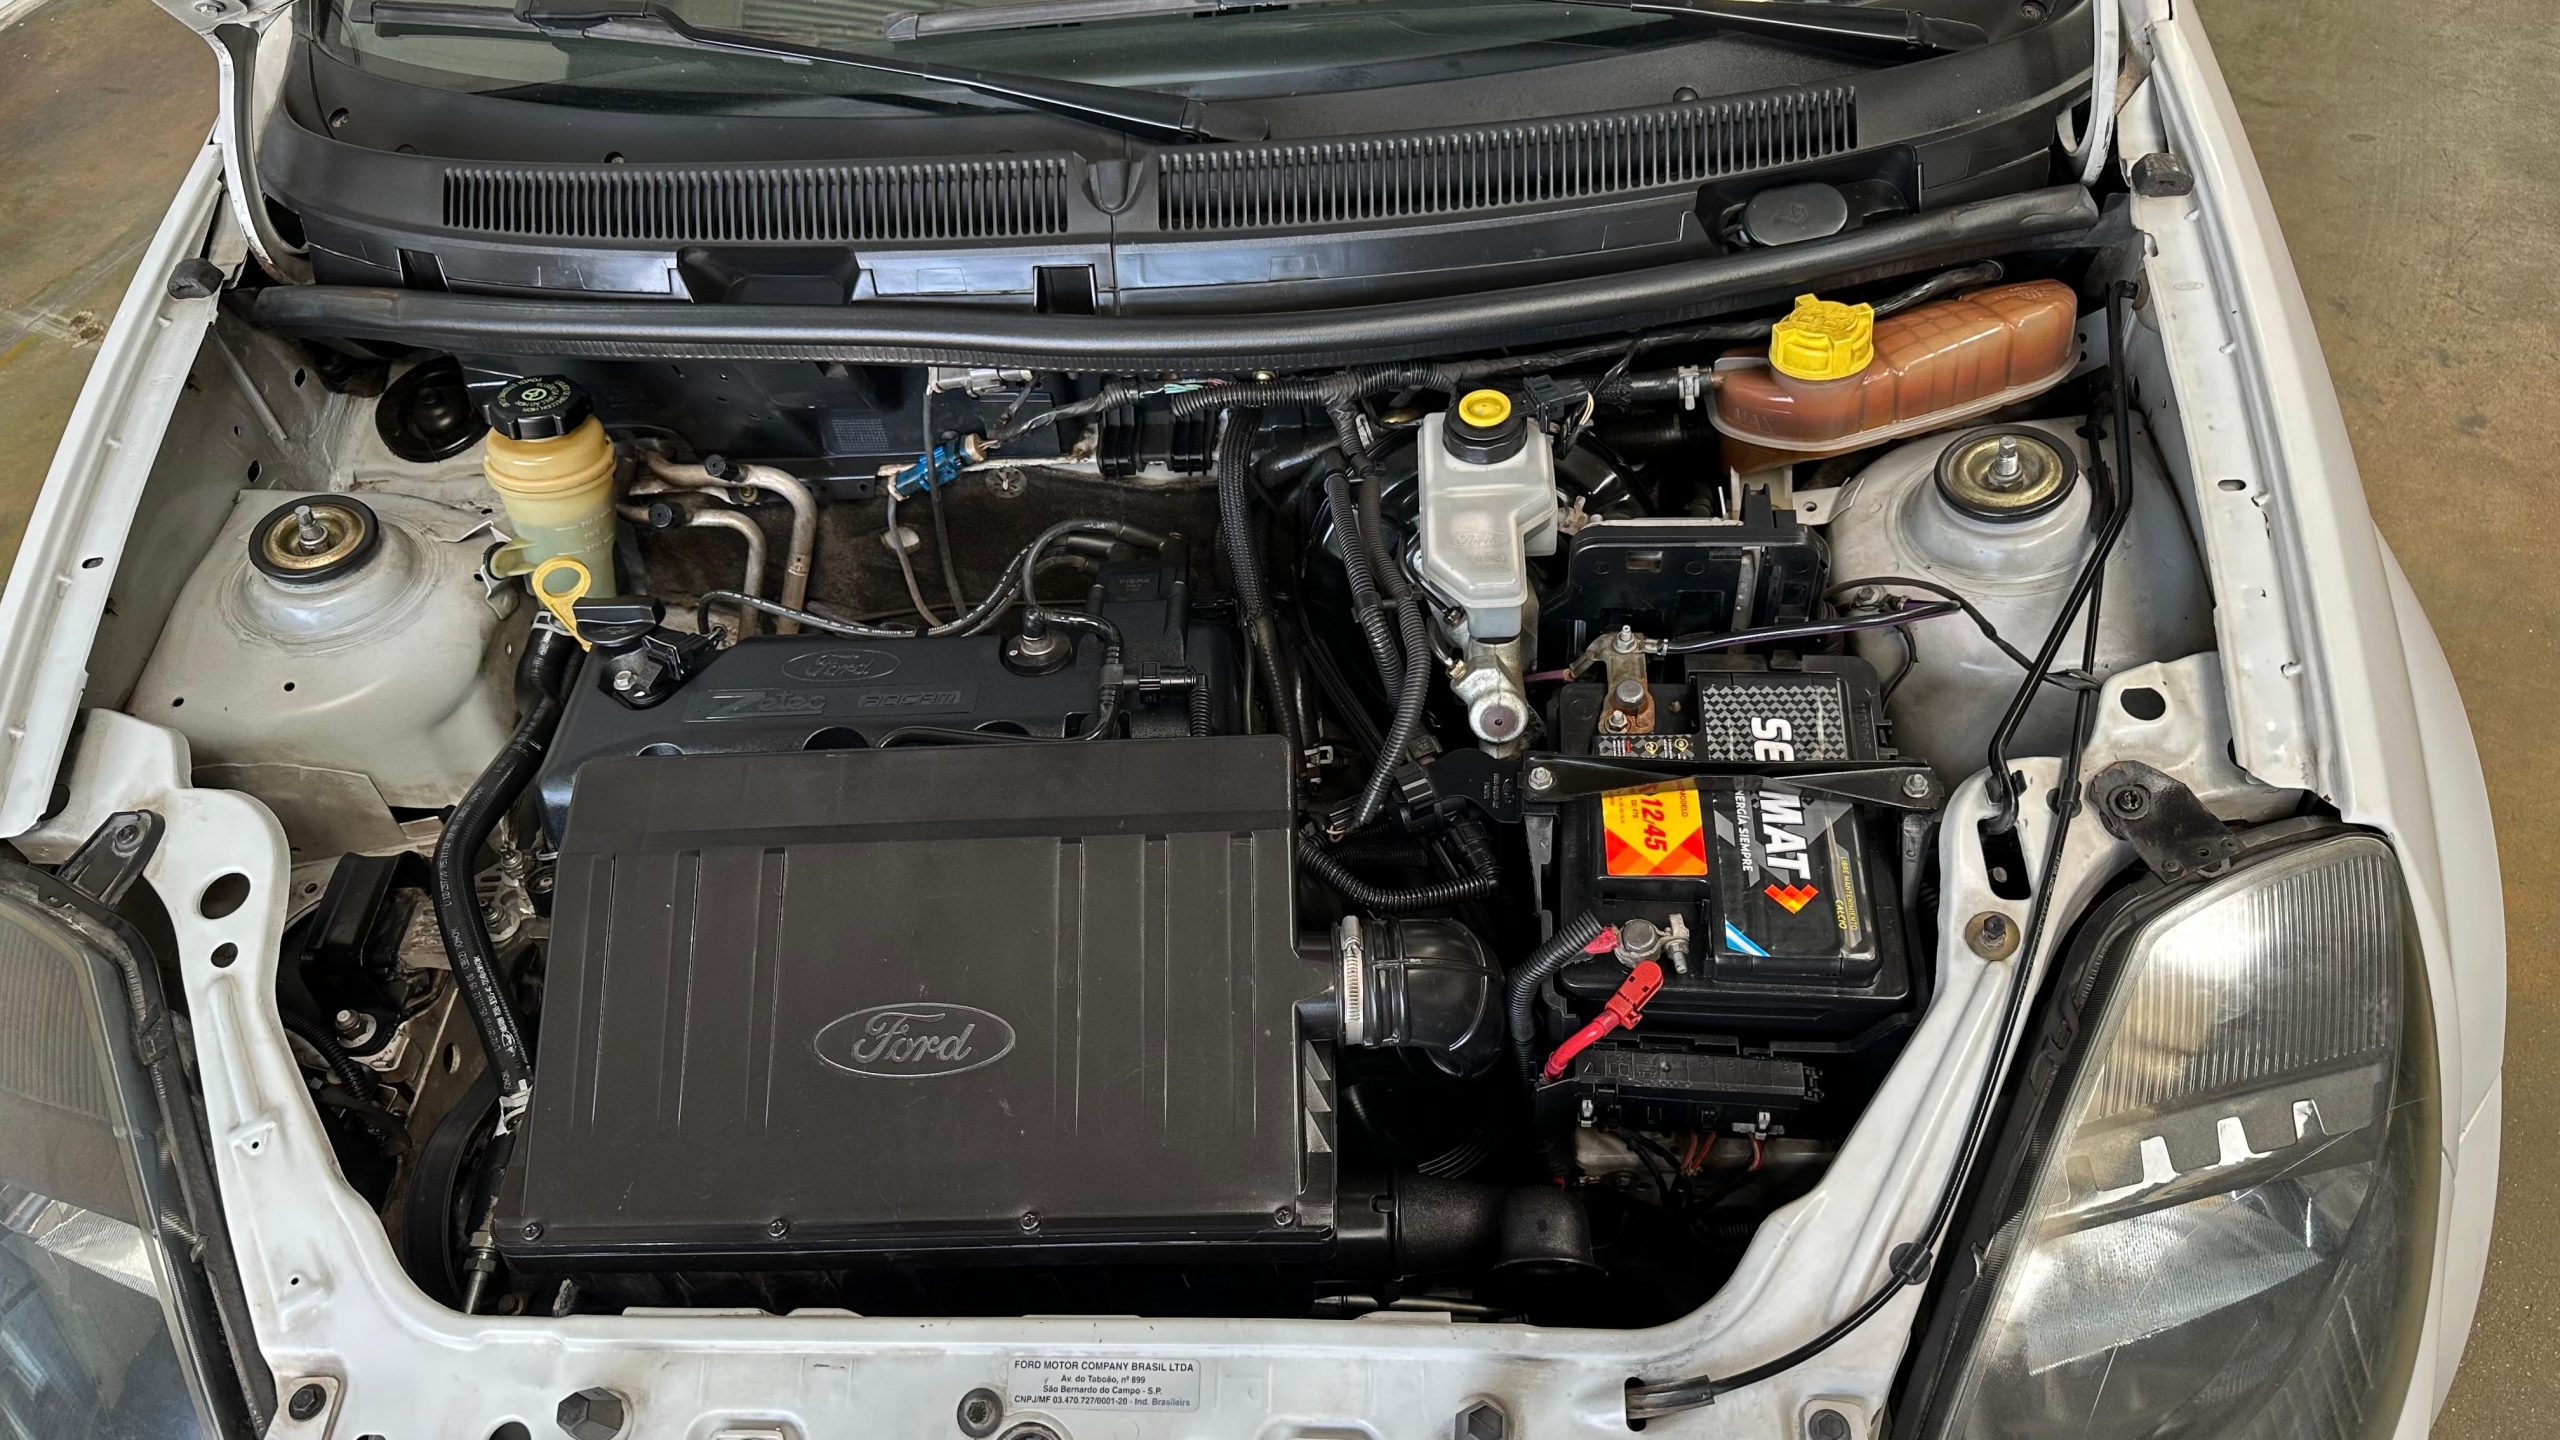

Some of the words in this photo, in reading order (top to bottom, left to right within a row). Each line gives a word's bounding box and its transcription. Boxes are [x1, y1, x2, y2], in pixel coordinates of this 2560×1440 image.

[806, 654, 875, 677] Ford
[706, 691, 827, 719] Zetec
[1680, 790, 1689, 818] MODELO
[1735, 791, 1751, 825] NERGÍA
[1641, 798, 1667, 852] 12/45
[1738, 828, 1753, 872] SIEMPRE
[1841, 856, 1850, 874] LIBRE
[1836, 900, 1848, 930] CALCIO
[1843, 875, 1858, 931] MANTENIMIENTO
[852, 1011, 976, 1065] Ford
[1014, 1360, 1041, 1369] FORD
[1043, 1361, 1079, 1370] MOTOR
[1081, 1361, 1129, 1371] COMPANY
[1131, 1362, 1167, 1372] BRASIL
[1169, 1363, 1194, 1372] LTDA
[1061, 1375, 1073, 1383] Av.
[1075, 1375, 1086, 1383] do
[1088, 1375, 1119, 1385] Taboão,
[1131, 1376, 1146, 1384] 899
[1014, 1395, 1051, 1404] CNPJ/MF
[1134, 1398, 1150, 1406] Ind.
[1042, 1385, 1059, 1393] São
[1060, 1385, 1098, 1394] Bernardo
[1099, 1386, 1110, 1394] do
[1111, 1386, 1141, 1396] Campo
[1147, 1386, 1163, 1395] S.P.
